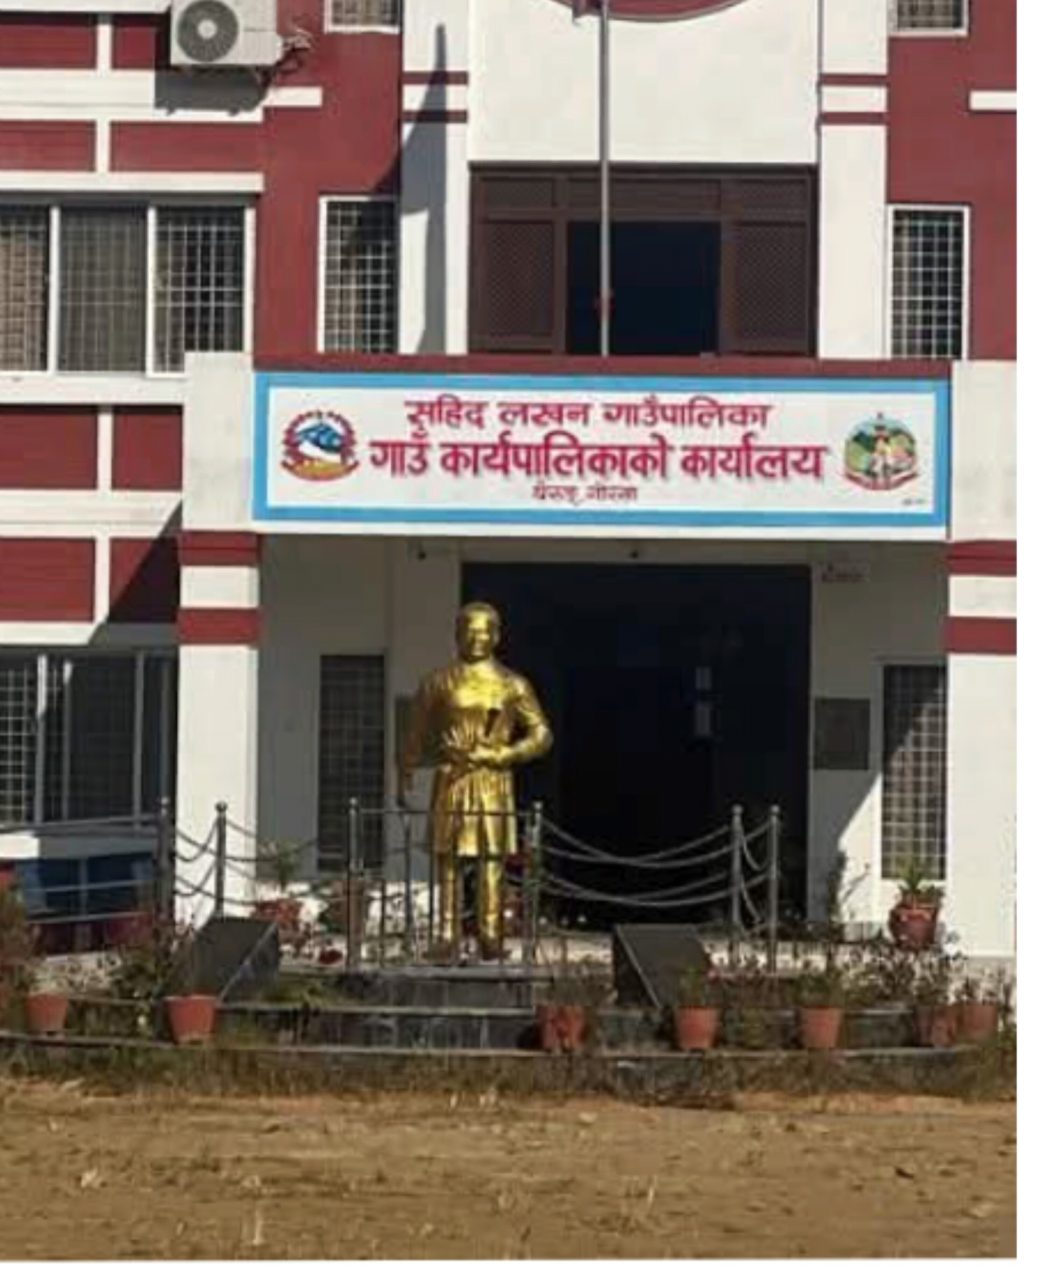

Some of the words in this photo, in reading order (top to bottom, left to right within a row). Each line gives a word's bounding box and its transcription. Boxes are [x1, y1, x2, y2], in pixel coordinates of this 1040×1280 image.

[496, 401, 592, 428] लखन
[600, 394, 774, 430] गाउँपालिका
[369, 423, 431, 478] गाउँ
[438, 429, 675, 480] कार्यपालिकाको
[680, 431, 829, 481] कार्यालय
